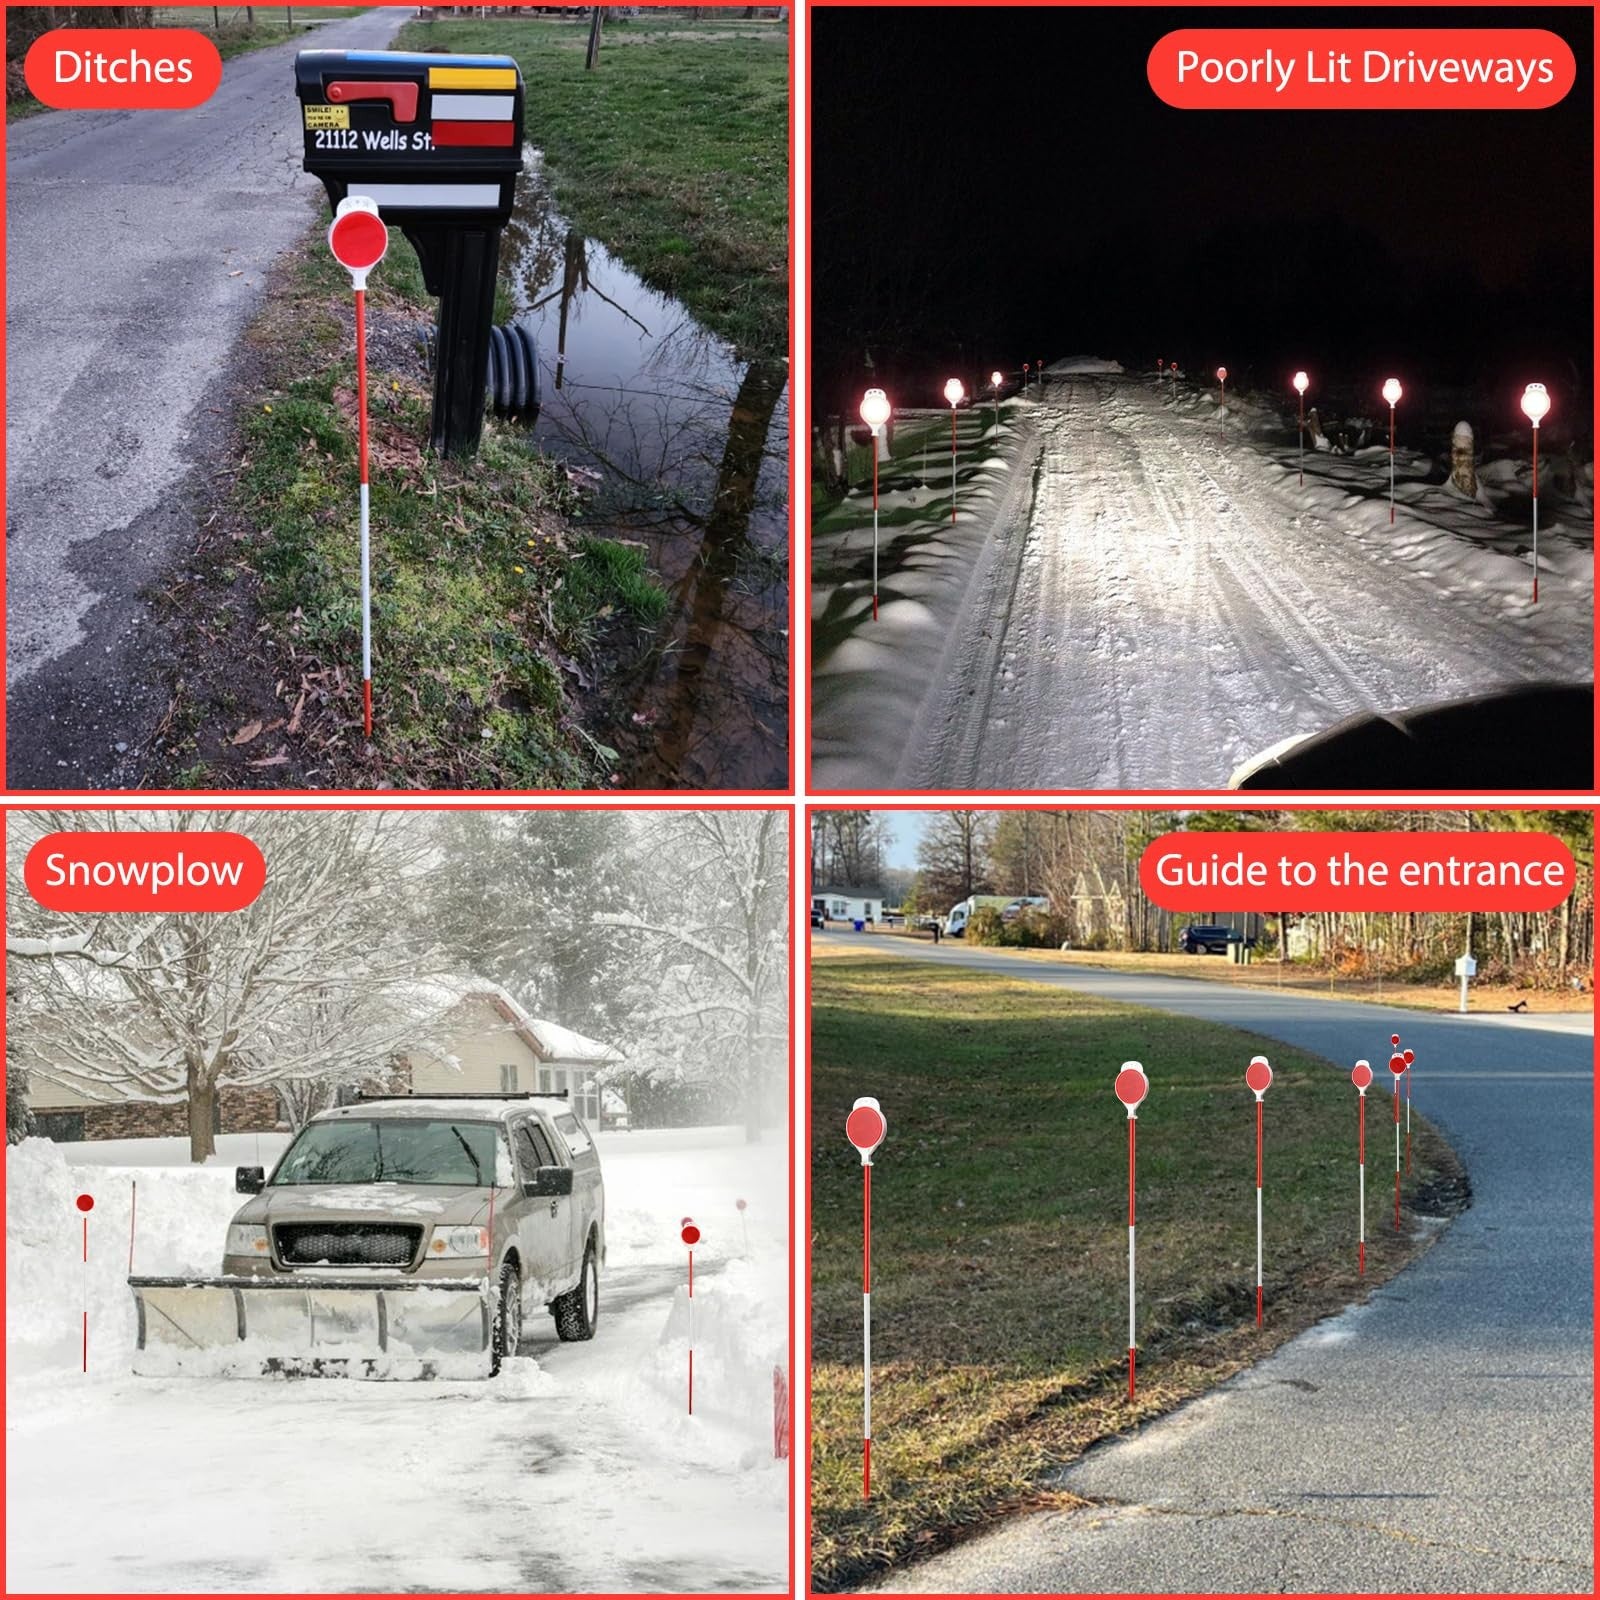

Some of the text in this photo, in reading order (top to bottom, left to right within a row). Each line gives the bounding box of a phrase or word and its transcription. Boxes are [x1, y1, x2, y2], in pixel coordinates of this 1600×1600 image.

[315, 129, 436, 151] 21112 Wells St.
